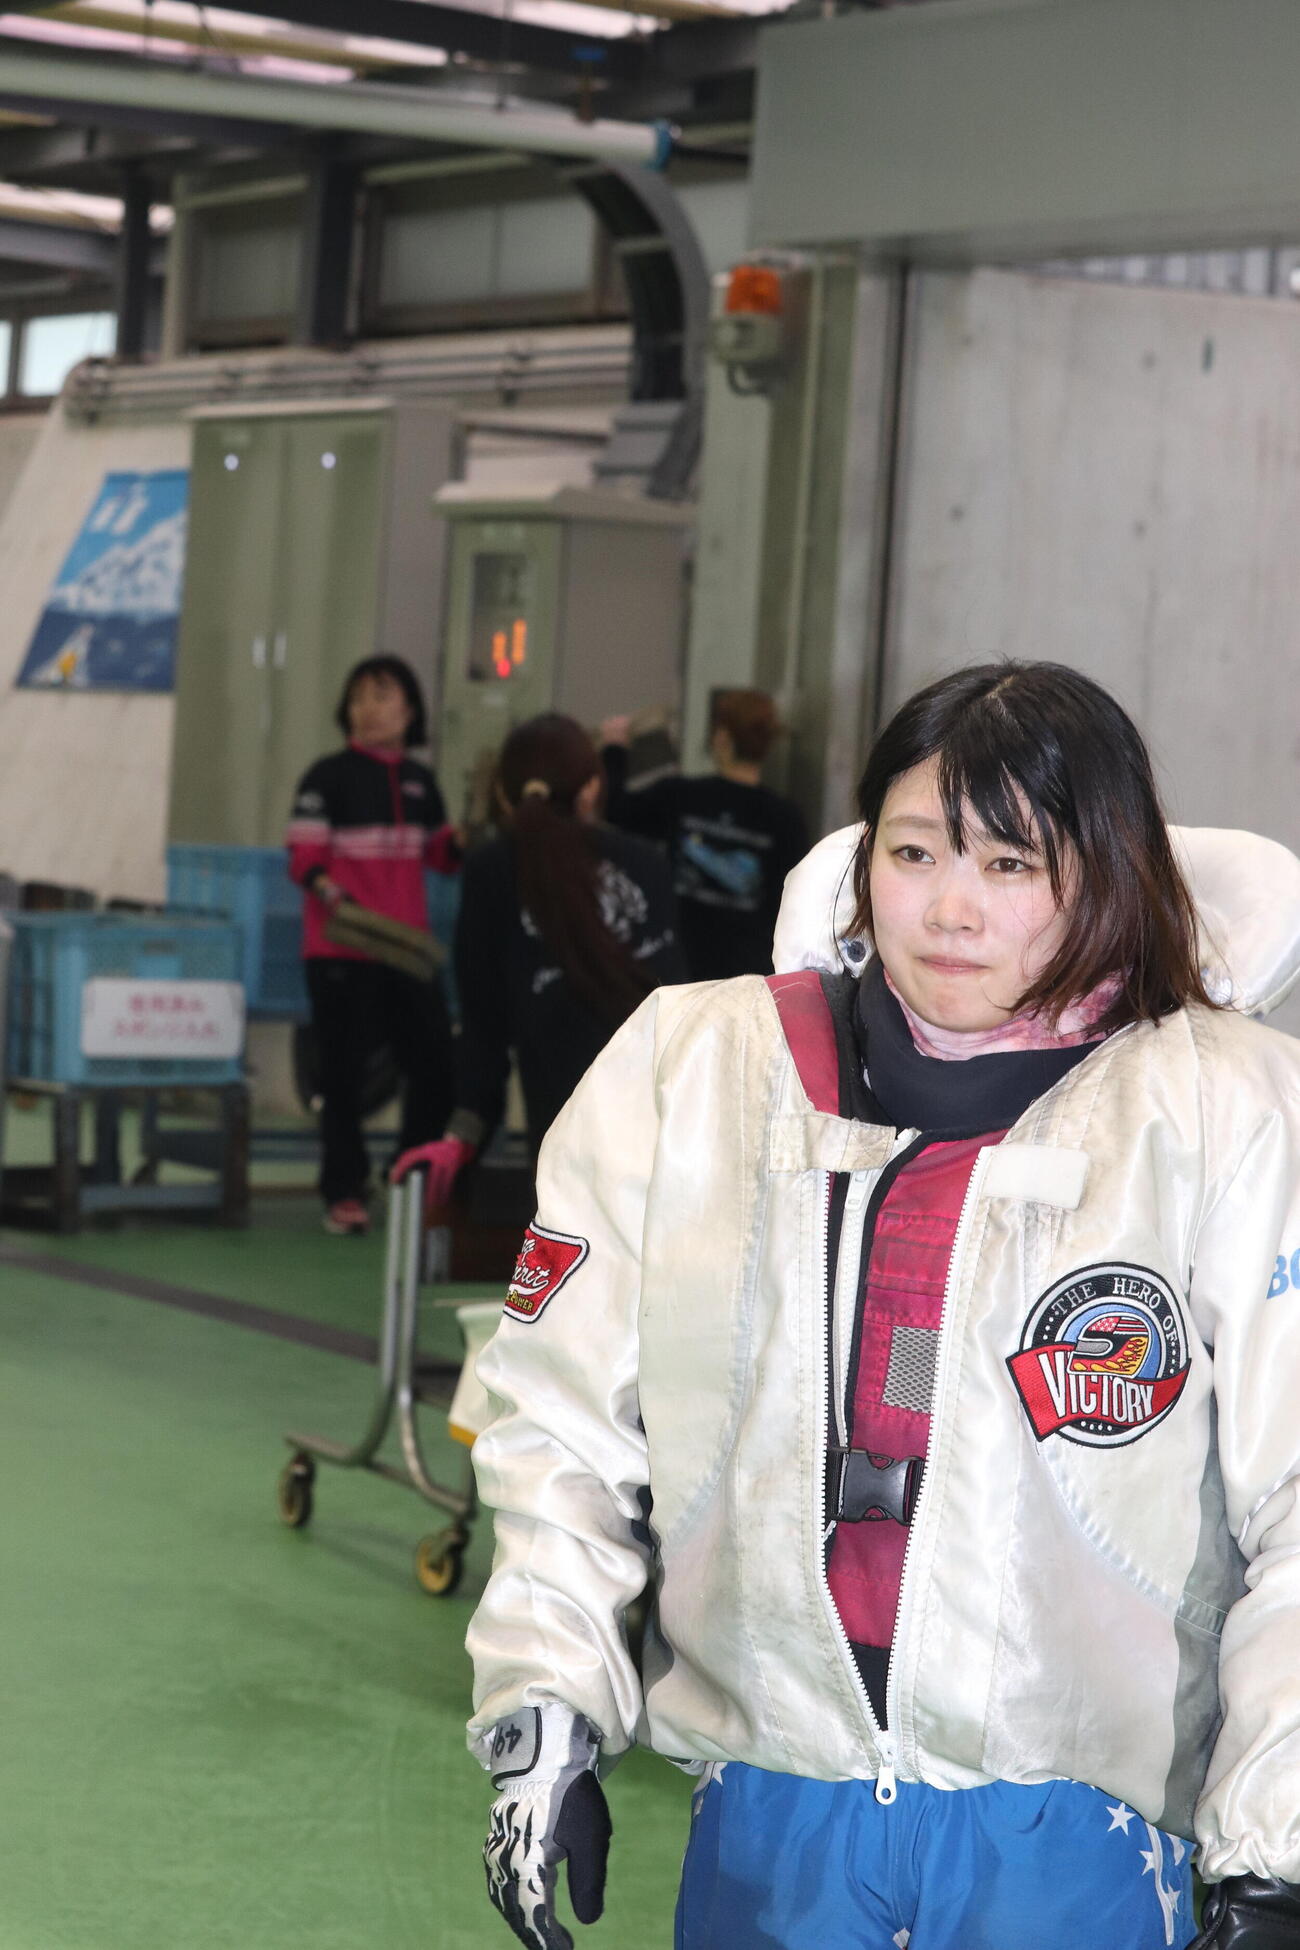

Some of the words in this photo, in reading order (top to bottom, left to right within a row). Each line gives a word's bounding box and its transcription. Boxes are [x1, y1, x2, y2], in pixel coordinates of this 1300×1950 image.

[1051, 1282, 1097, 1316] THE
[1112, 1277, 1161, 1310] HERO
[1162, 1315, 1178, 1341] OF
[1036, 1350, 1154, 1424] VICTORY
